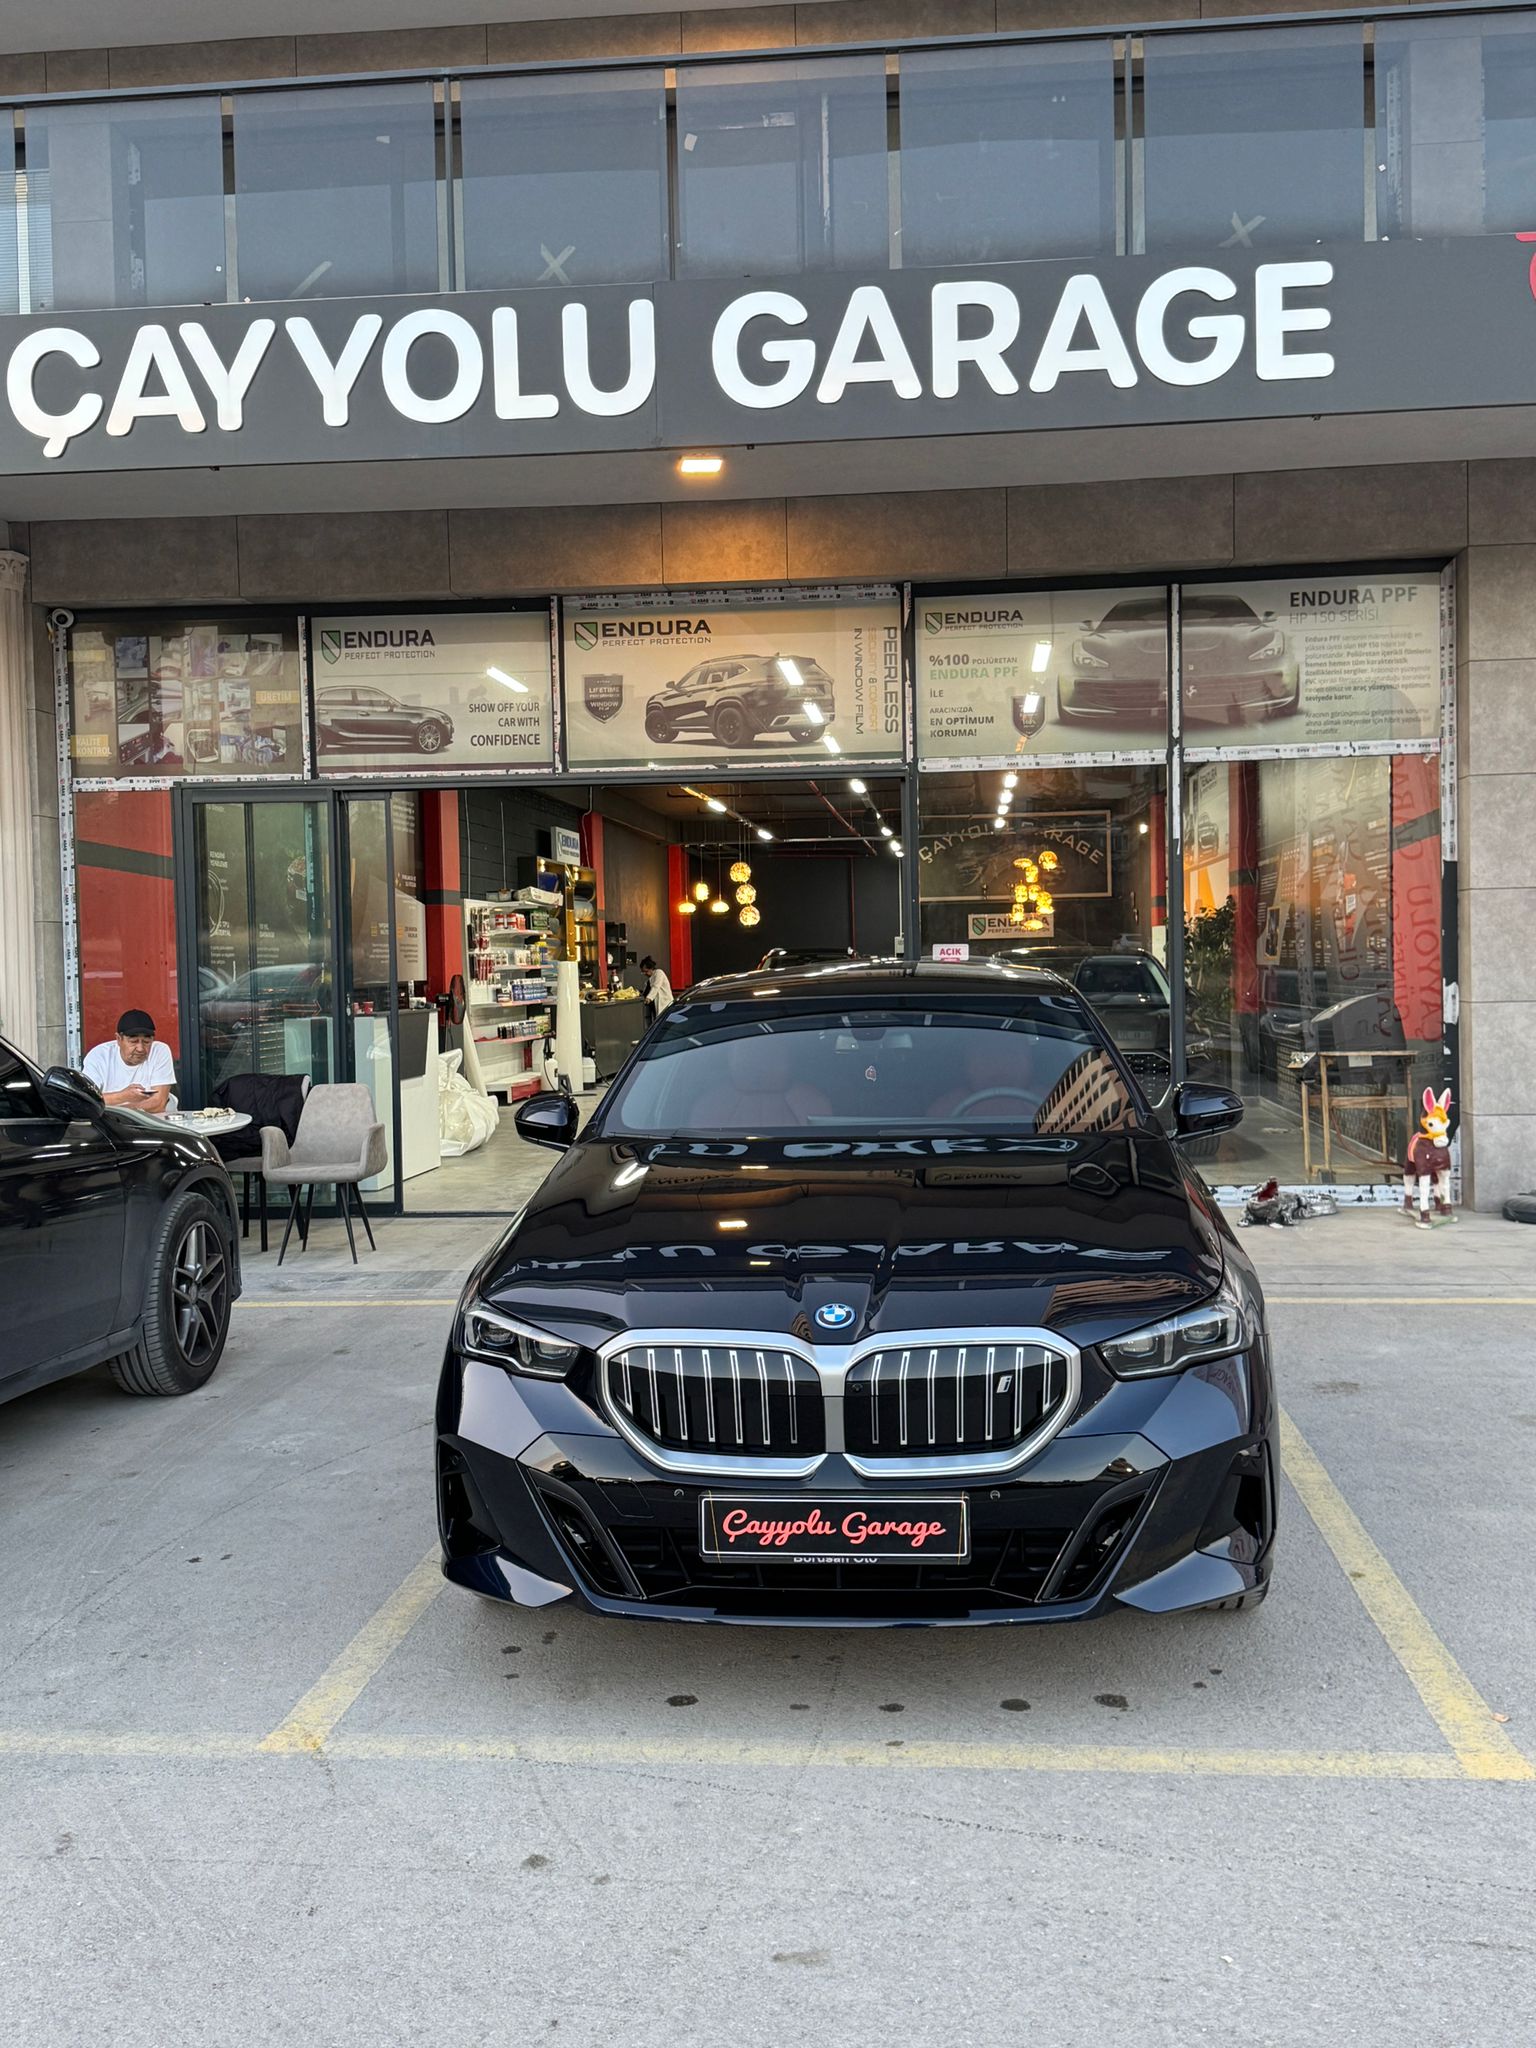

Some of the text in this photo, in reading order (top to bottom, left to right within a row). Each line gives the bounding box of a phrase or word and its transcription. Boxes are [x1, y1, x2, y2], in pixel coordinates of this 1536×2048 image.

[6, 261, 1334, 459] ÇAYYOLU GARAGE
[1290, 586, 1418, 607] ENDURA PPF
[945, 610, 1023, 624] ENDURA
[602, 620, 712, 637] ENDURA
[344, 629, 435, 648] ENDURA
[602, 637, 712, 647] PERFECT PROTECTION
[345, 650, 436, 660] PERFECT PROTECTION
[929, 654, 970, 667] %100
[930, 666, 1019, 680] ENDURA PPF
[854, 628, 864, 735] IN WINDOW FILM
[883, 626, 899, 734] PEERLESS
[930, 688, 944, 698] İLE
[469, 702, 540, 713] SHOW OFF YOUR
[498, 717, 540, 727] CAR WITH
[930, 714, 994, 726] EN OPTİMUM
[470, 733, 541, 746] CONFIDENCE
[930, 728, 977, 738] KORUMA!
[722, 1508, 947, 1547] Çayyolu Garage
